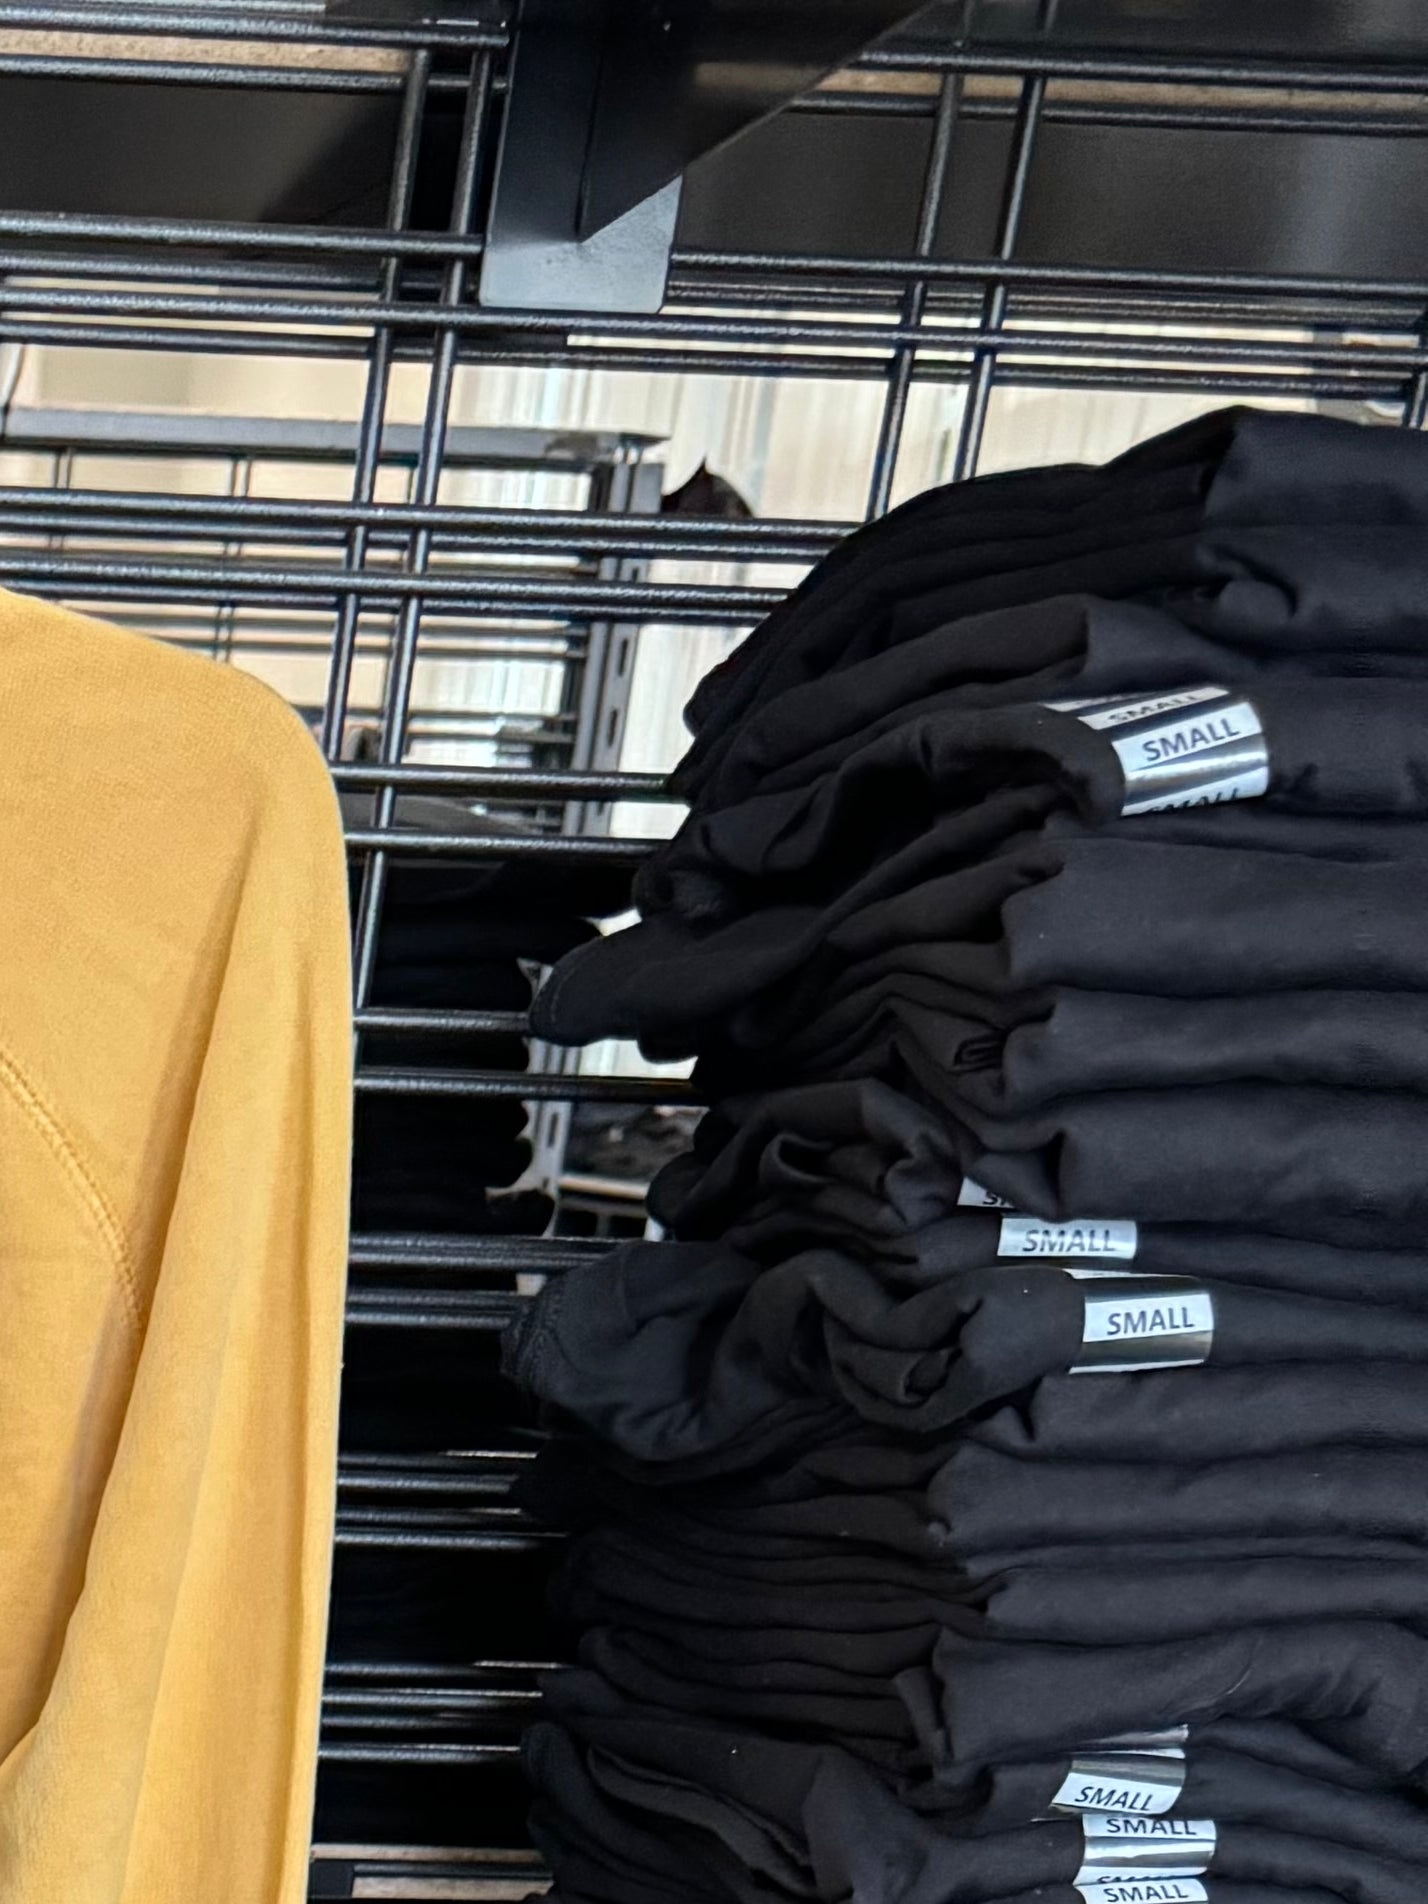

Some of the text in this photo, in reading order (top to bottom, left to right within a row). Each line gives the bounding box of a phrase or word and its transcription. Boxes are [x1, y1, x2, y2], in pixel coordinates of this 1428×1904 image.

[1142, 717, 1240, 762] SMALL
[1020, 1229, 1117, 1254] SMALL
[1105, 1307, 1196, 1336] SMALL
[1074, 1786, 1155, 1811] SMALL
[1105, 1817, 1198, 1836] SMALL
[1102, 1885, 1189, 1903] SMALL
